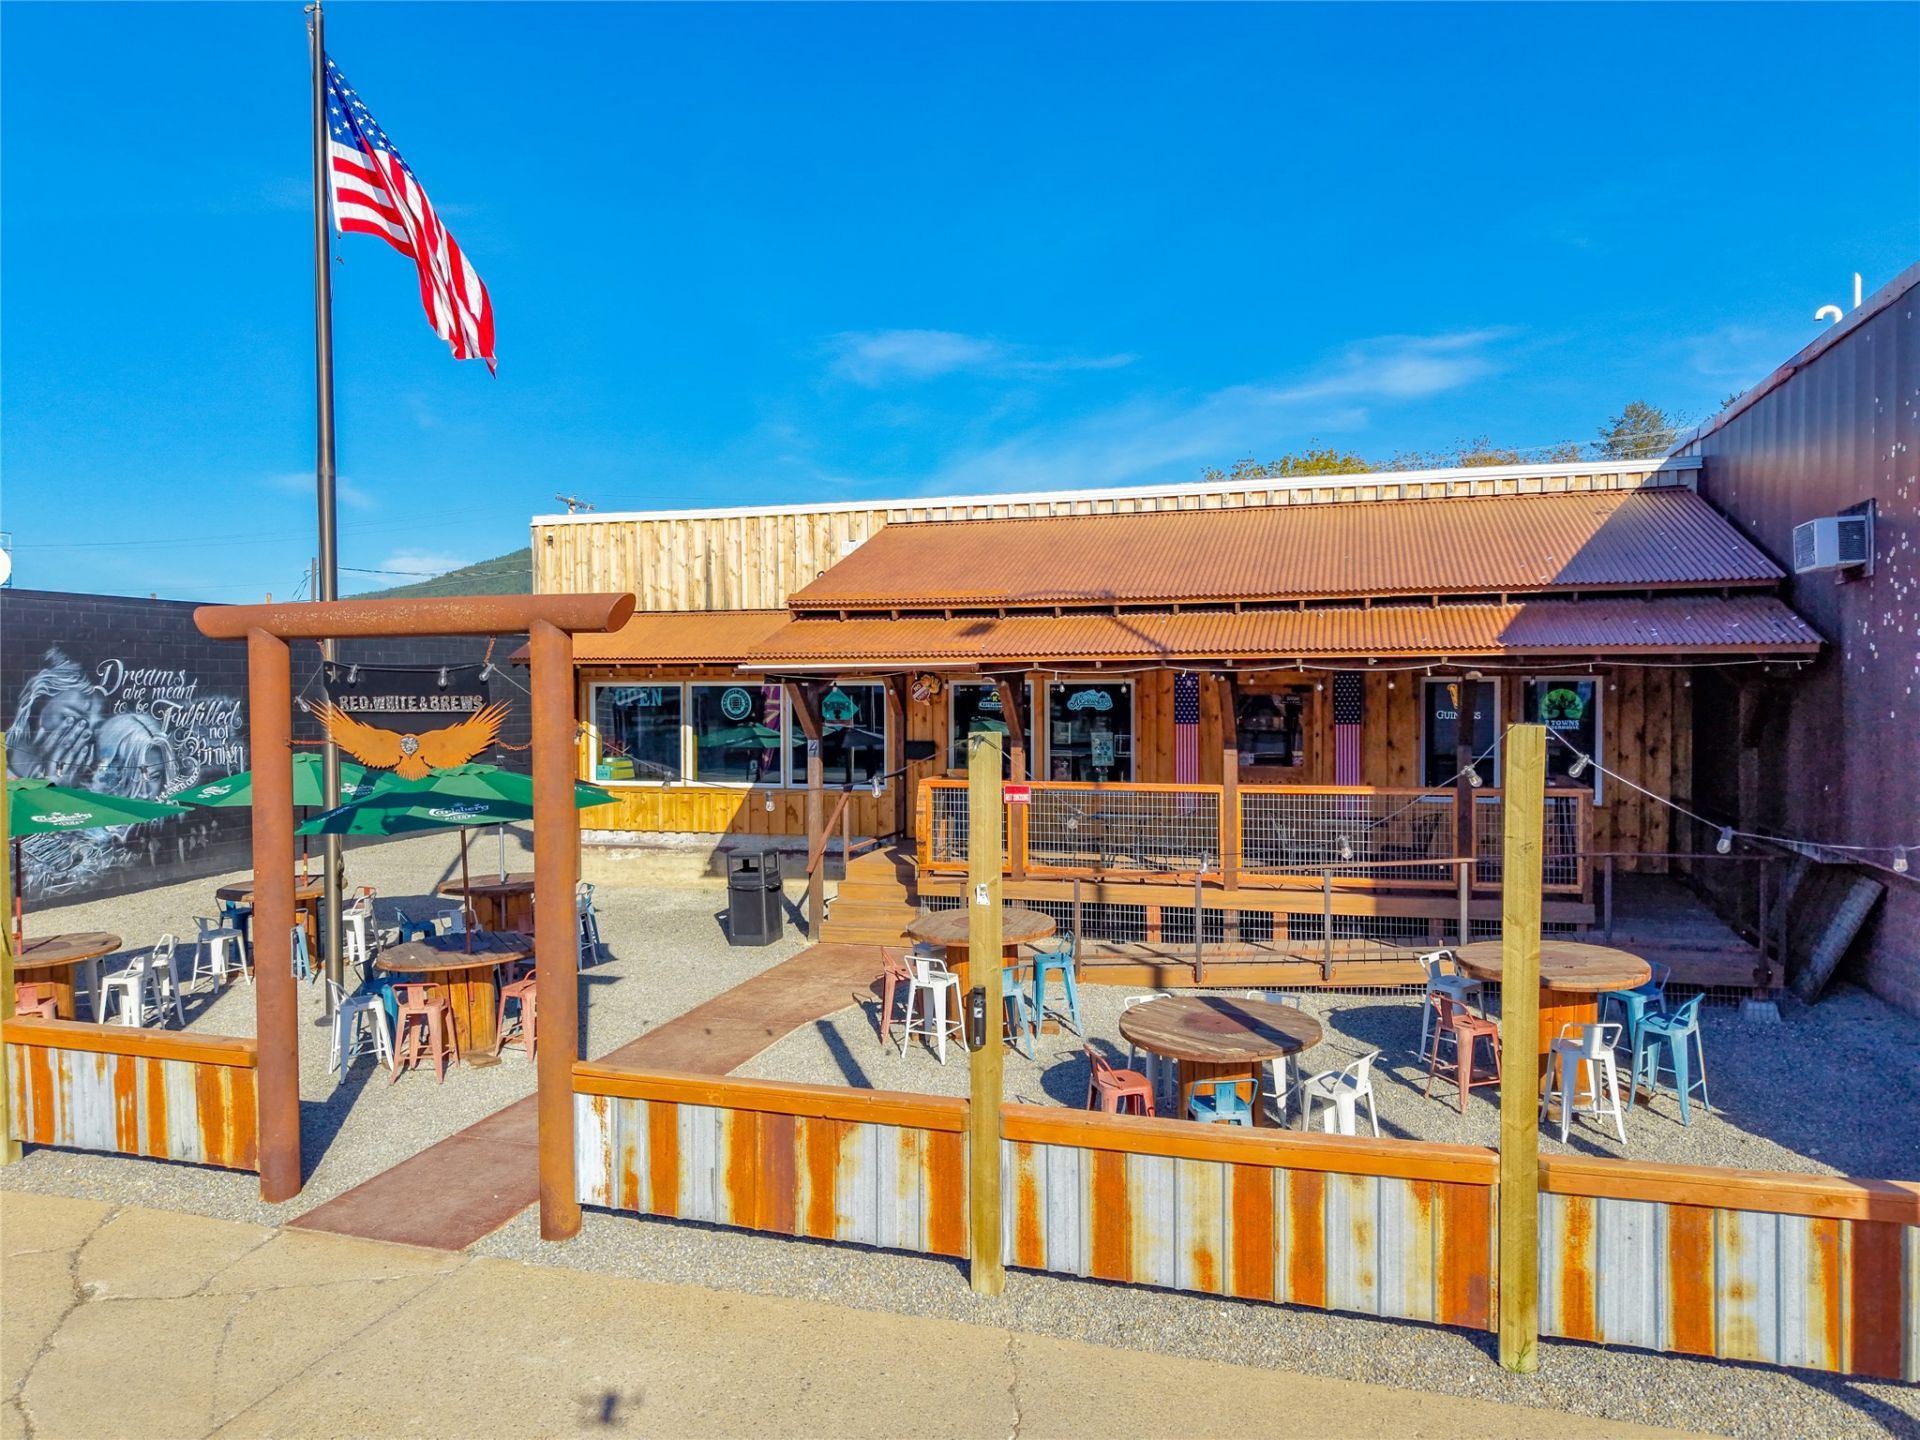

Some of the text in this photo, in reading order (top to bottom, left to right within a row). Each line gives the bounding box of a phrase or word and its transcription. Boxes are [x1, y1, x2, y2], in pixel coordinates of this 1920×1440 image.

[93, 658, 186, 697] Dreams
[151, 677, 198, 703] meant
[615, 687, 663, 706] OPEN
[113, 699, 127, 714] to
[135, 699, 149, 714] be
[373, 696, 418, 711] WHITE
[420, 696, 428, 711] &
[430, 695, 483, 711] BREWS
[209, 724, 229, 739] not
